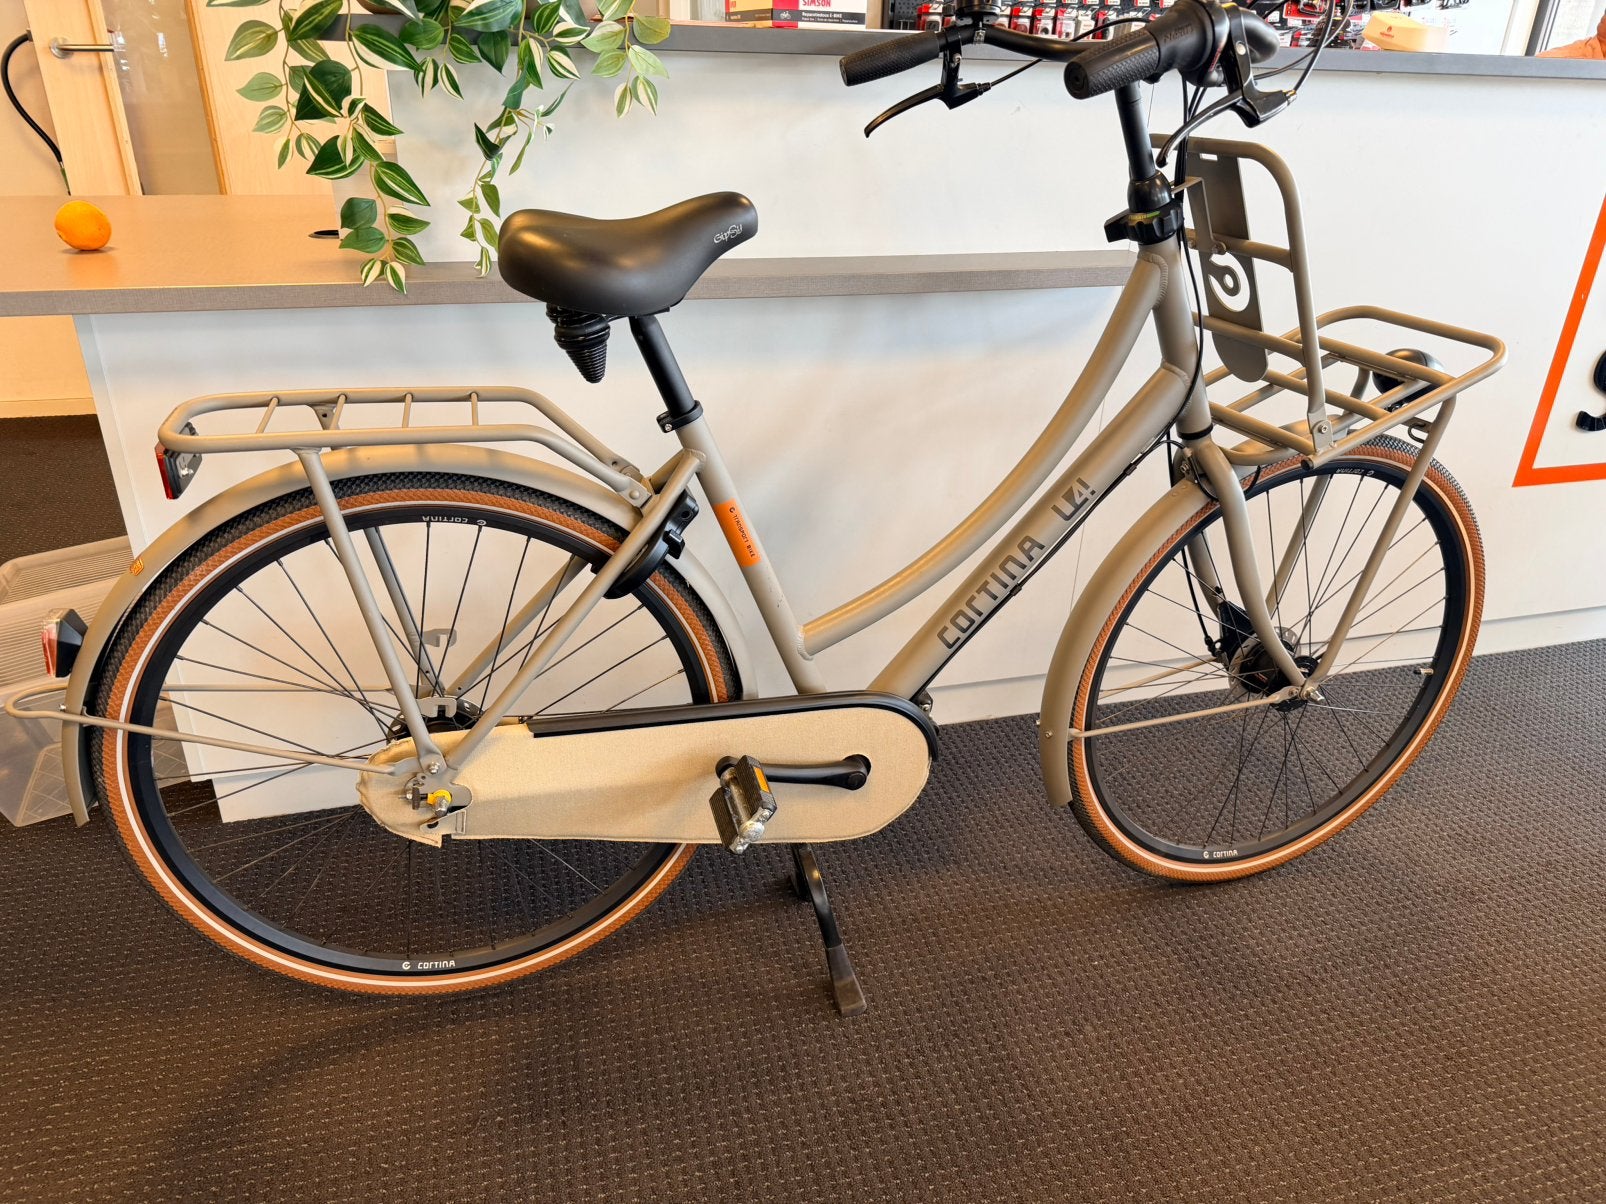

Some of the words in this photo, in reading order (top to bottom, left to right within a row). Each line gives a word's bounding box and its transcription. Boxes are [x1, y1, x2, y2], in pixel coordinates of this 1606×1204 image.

[422, 515, 469, 524] CORTINA
[937, 535, 1046, 650] CORTINA
[1213, 849, 1239, 858] CORTINA
[417, 960, 456, 970] CORTINA
